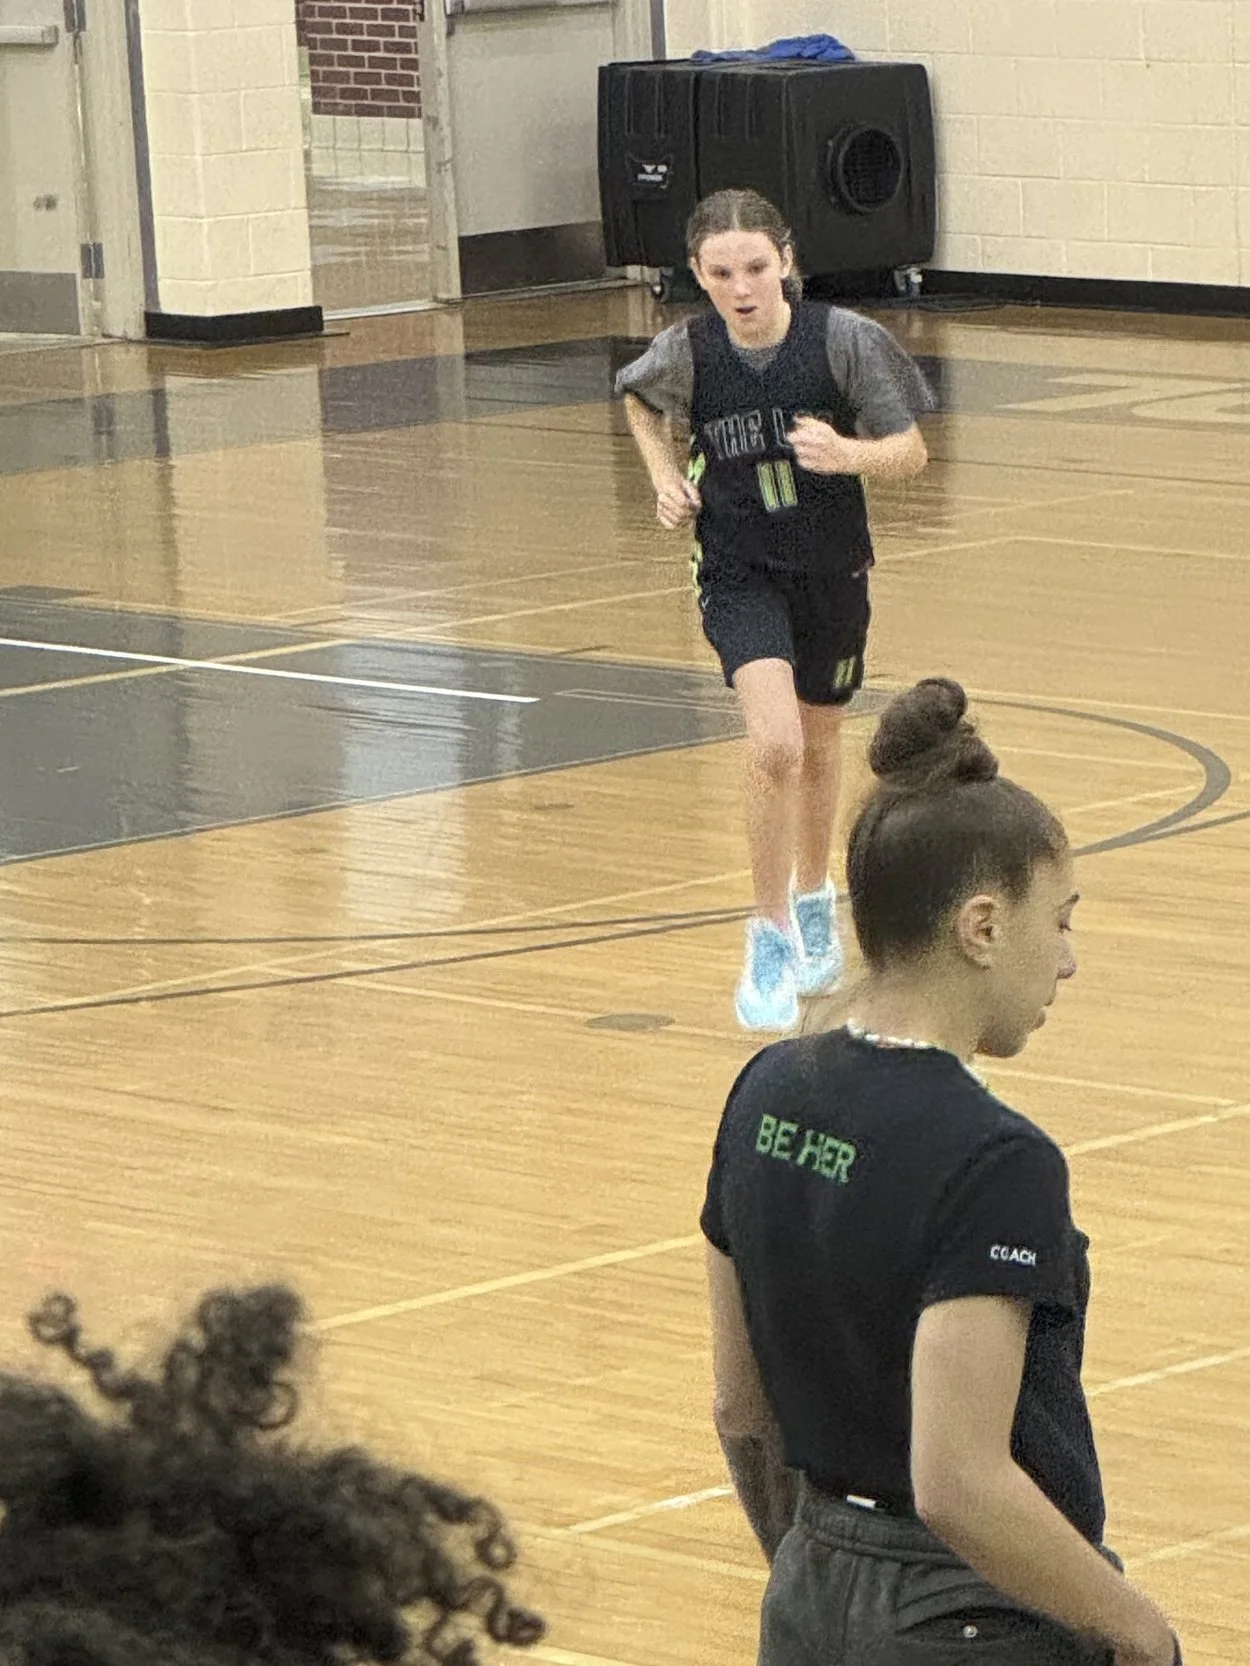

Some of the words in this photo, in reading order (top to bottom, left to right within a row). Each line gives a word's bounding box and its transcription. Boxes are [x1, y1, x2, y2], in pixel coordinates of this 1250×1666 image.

[756, 460, 798, 513] 11
[756, 1113, 800, 1160] BE
[796, 1128, 857, 1184] HER
[989, 1244, 1038, 1267] COACH
